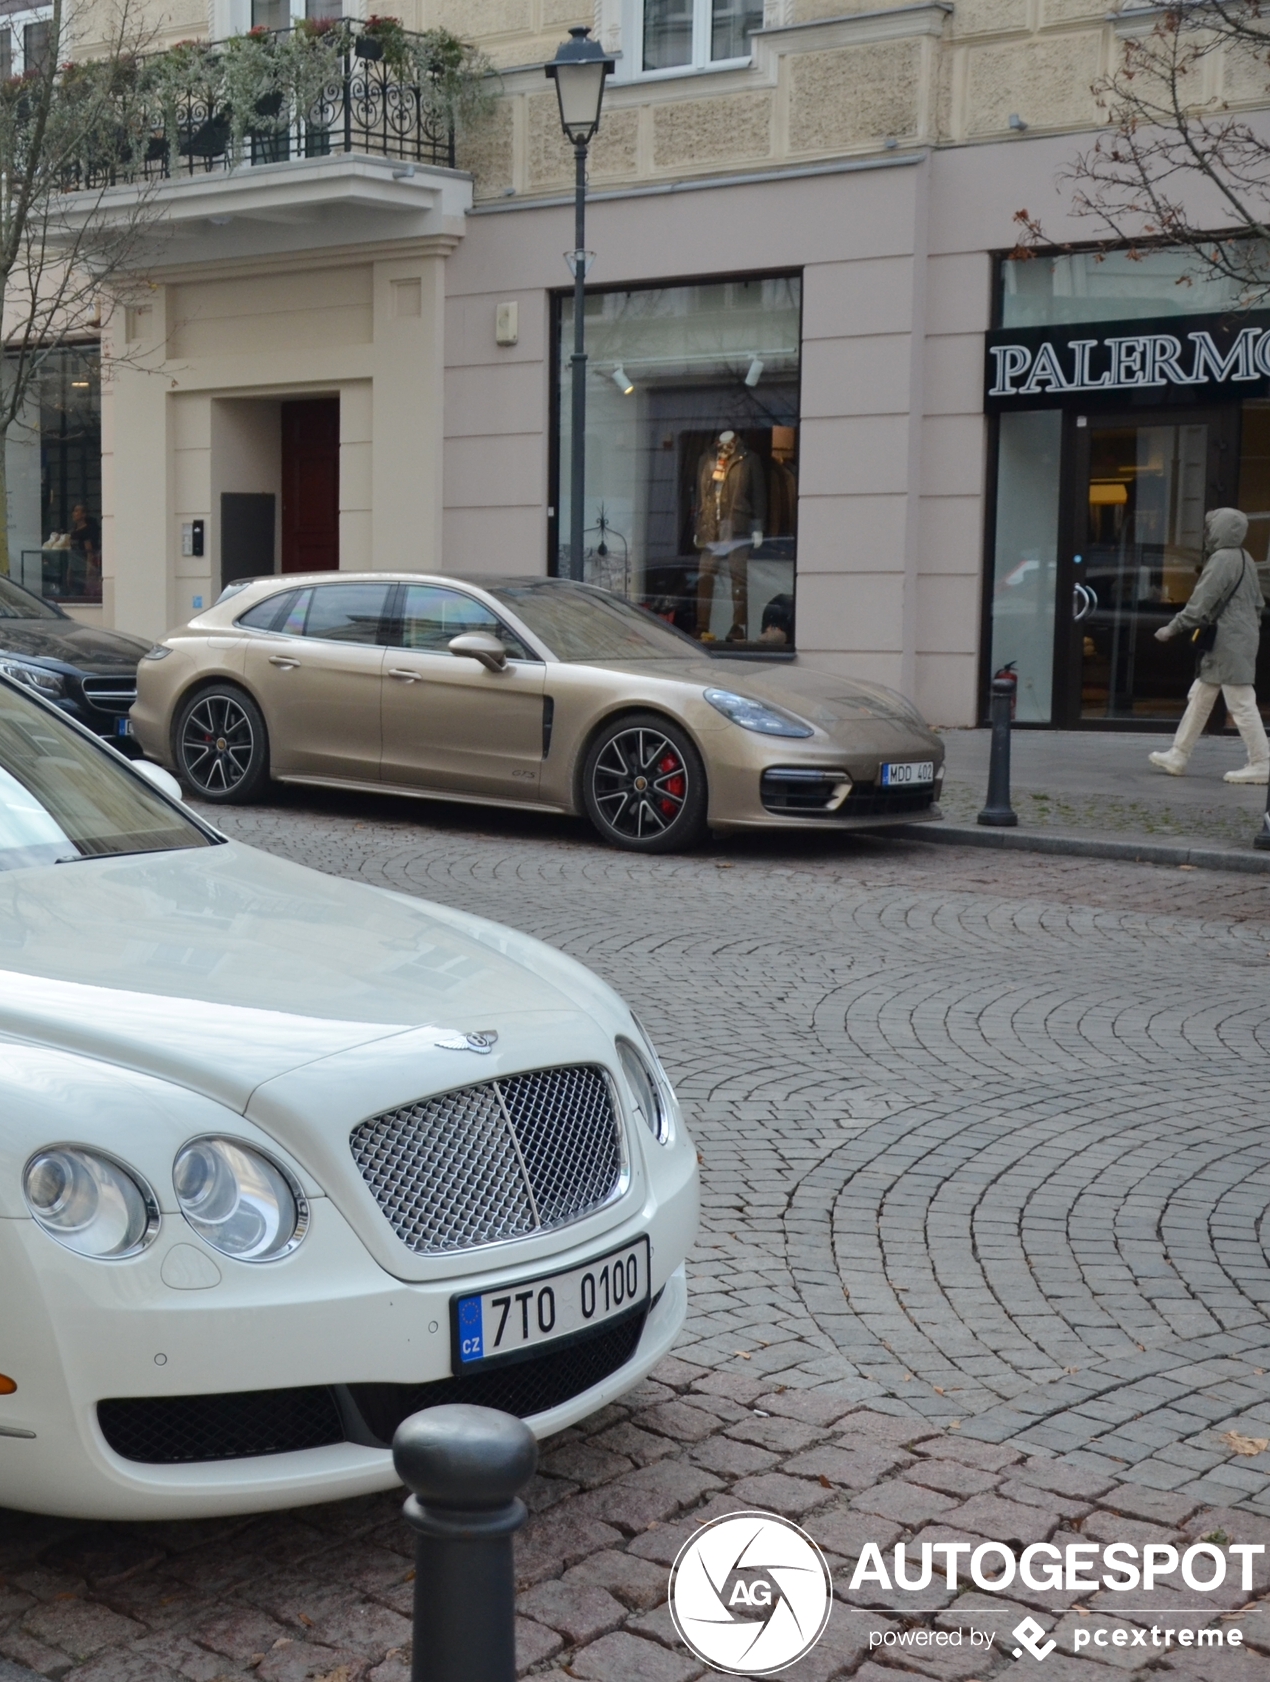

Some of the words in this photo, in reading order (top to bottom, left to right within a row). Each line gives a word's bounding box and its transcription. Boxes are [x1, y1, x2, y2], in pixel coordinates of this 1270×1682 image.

[890, 765, 912, 782] MDD
[581, 1253, 637, 1319] 0100
[462, 1337, 480, 1354] CZ
